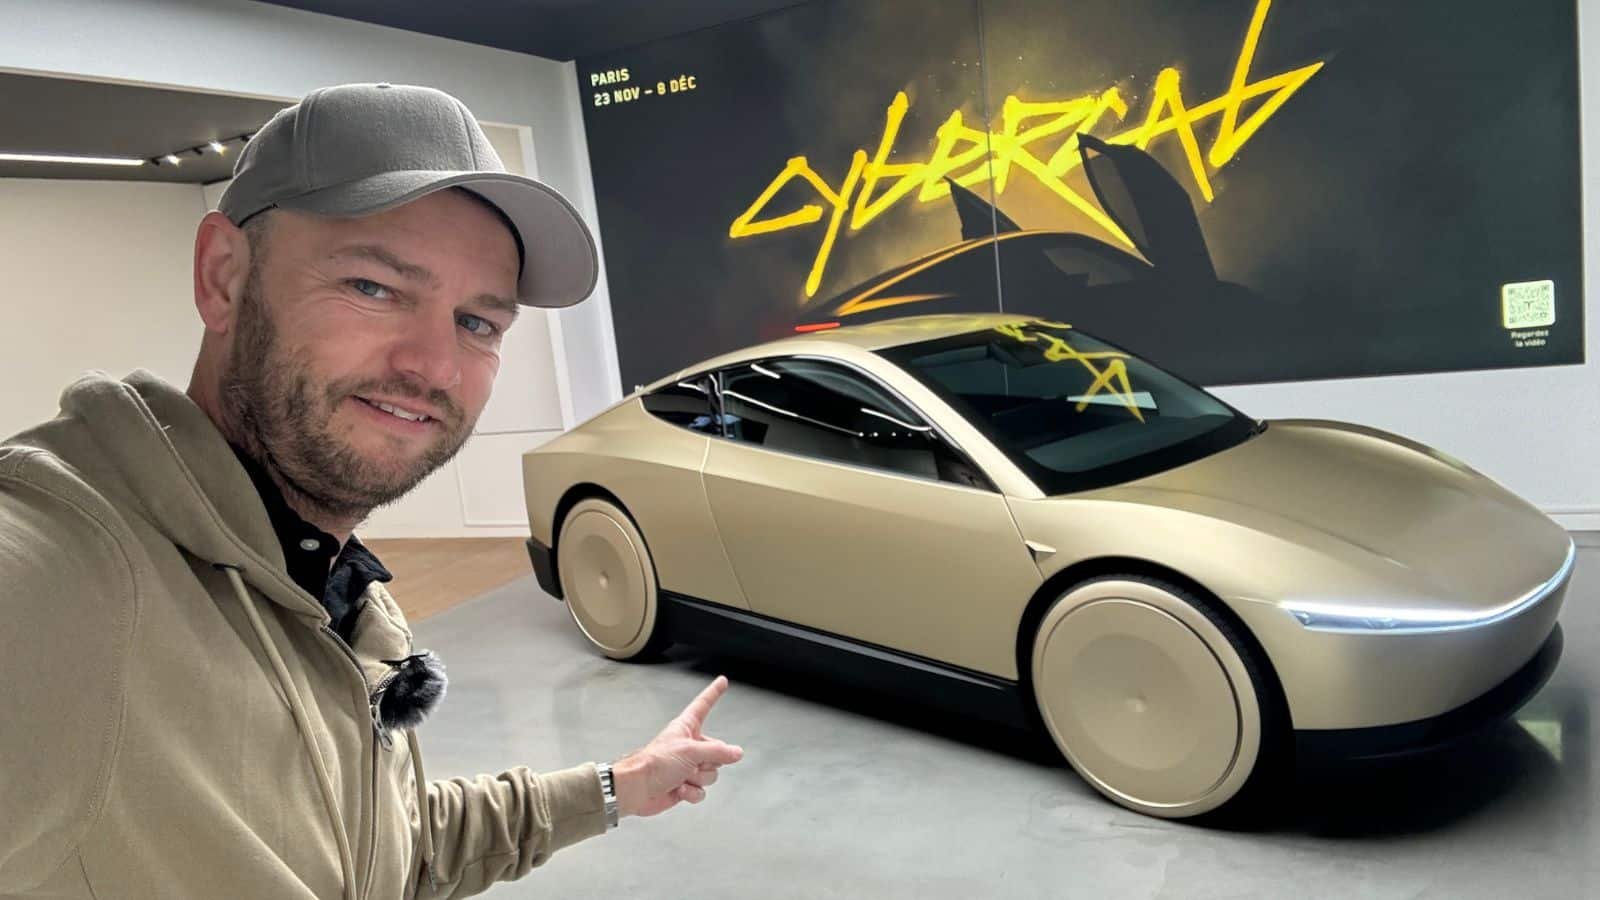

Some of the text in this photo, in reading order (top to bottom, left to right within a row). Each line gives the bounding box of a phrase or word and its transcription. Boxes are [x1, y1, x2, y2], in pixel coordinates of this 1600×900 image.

[590, 68, 630, 87] PARIS
[593, 92, 611, 107] 23
[613, 87, 640, 103] NOV
[656, 81, 667, 96] 8
[669, 74, 696, 93] DÉC
